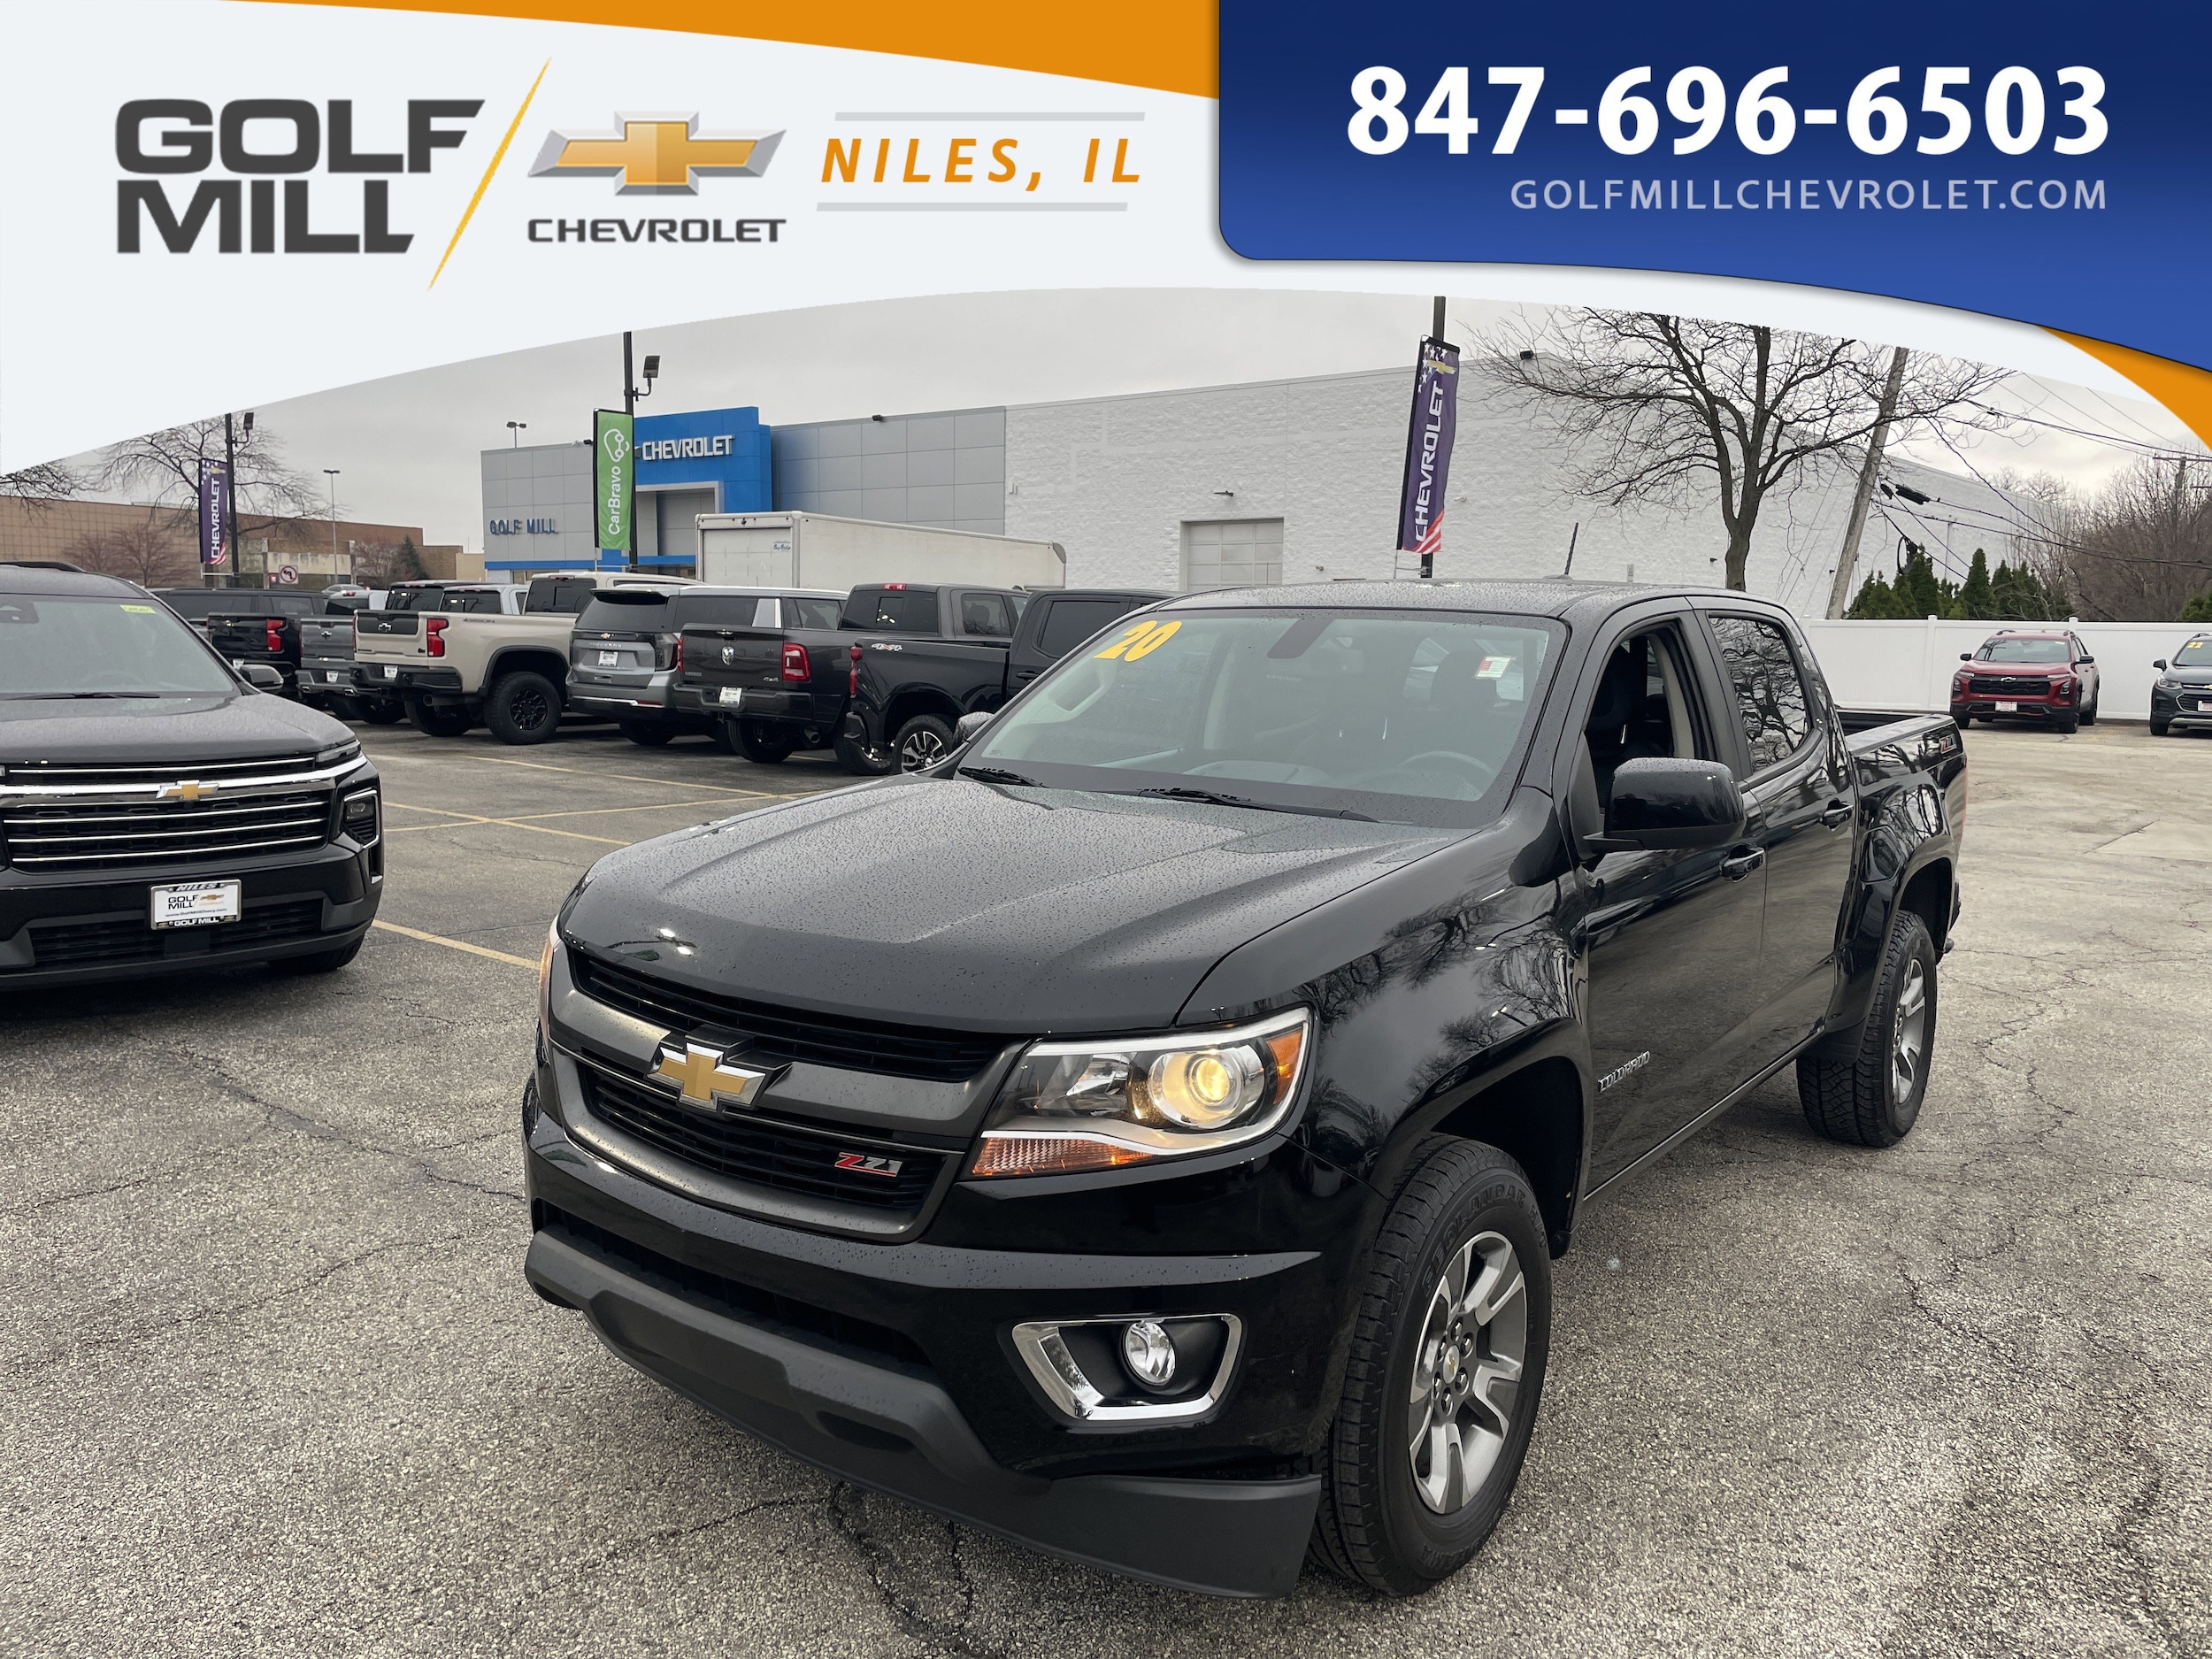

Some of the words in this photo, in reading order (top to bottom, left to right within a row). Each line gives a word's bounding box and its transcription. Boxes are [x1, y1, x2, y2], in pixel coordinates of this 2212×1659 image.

[641, 434, 735, 462] CHEVROLET
[1415, 380, 1444, 541] CHEVROLET
[608, 465, 622, 536] CarBravo
[211, 477, 221, 559] CHEVROLET
[489, 518, 523, 536] GOLF
[526, 518, 559, 536] MILL
[1092, 620, 1183, 663] 20
[1939, 733, 1957, 754] Z71
[168, 894, 199, 903] GOLF
[175, 883, 218, 892] NILES
[168, 902, 194, 910] MILL
[173, 918, 197, 927] GOLF
[197, 917, 219, 926] MILL
[1597, 1050, 1650, 1094] COLORADO
[834, 1151, 902, 1178] Z71
